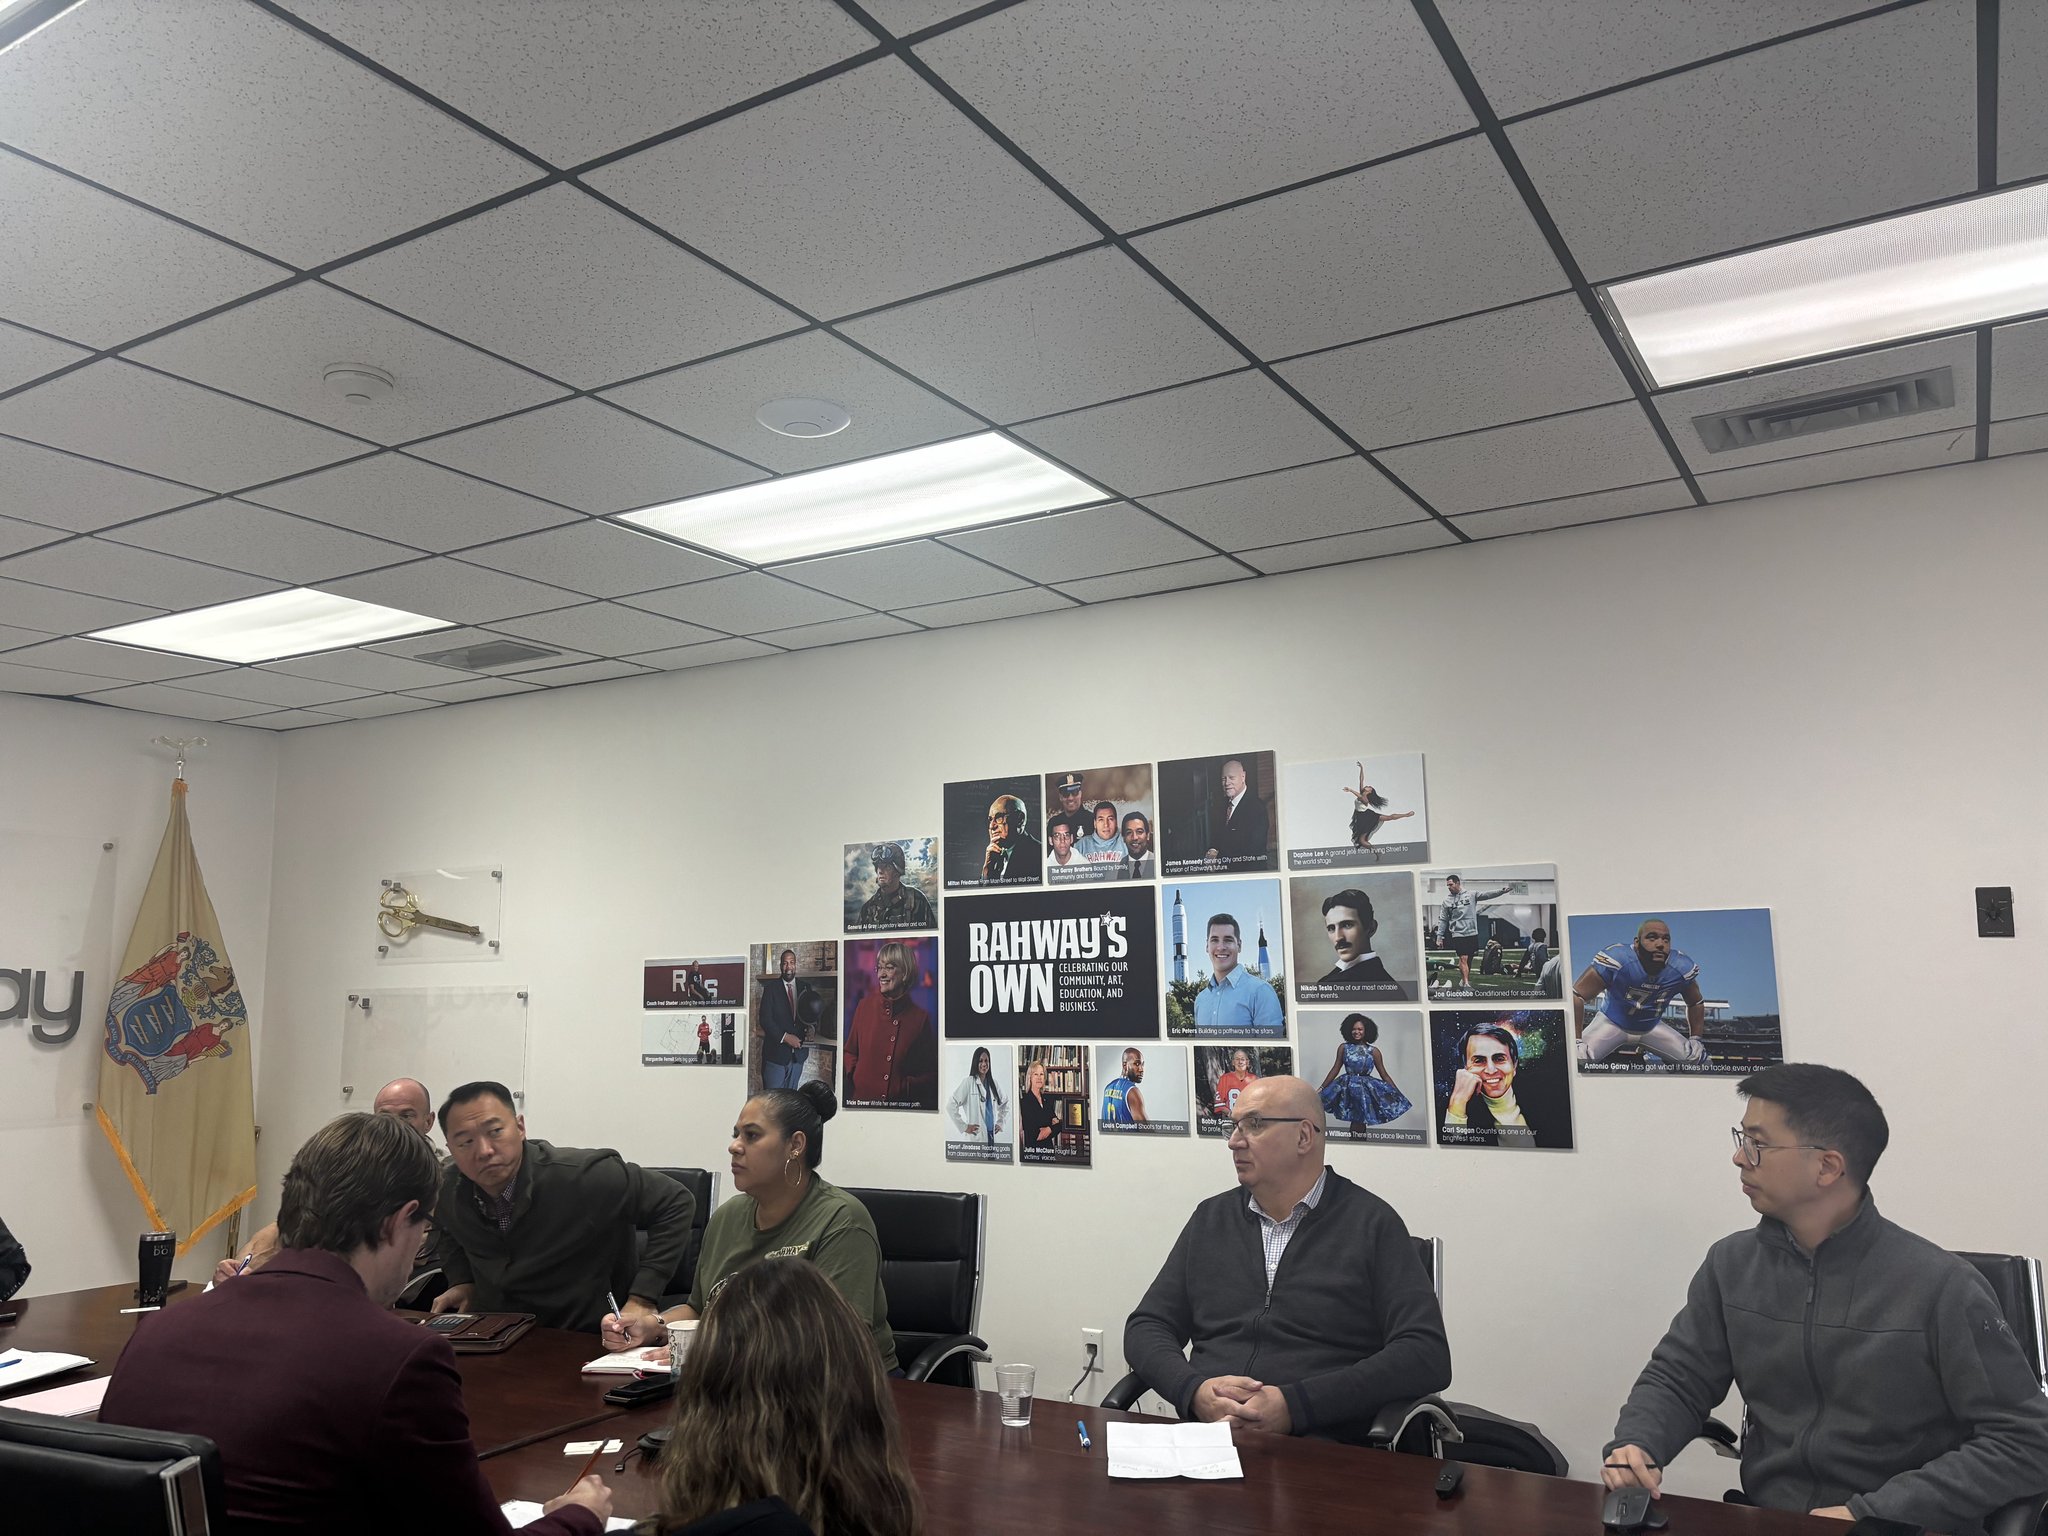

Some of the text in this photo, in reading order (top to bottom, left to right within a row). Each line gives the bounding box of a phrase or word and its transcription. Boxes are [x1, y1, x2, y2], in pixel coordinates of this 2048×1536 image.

[1330, 849, 1346, 858] grand
[1358, 847, 1370, 855] from
[1371, 846, 1385, 855] Irving
[1386, 845, 1402, 853] Street
[1402, 844, 1409, 852] to
[1165, 859, 1182, 867] James
[1182, 857, 1203, 866] Kennedy
[1203, 856, 1222, 866] Serving
[1222, 856, 1232, 864] City
[1256, 853, 1268, 861] with
[1060, 867, 1073, 875] Garay
[1108, 864, 1115, 872] by
[1189, 864, 1214, 874] Rahway's
[947, 879, 960, 887] Milton
[960, 878, 980, 886] Friedman
[878, 921, 897, 930] Legendary
[1058, 961, 1129, 974] CELEBRATING OUR
[672, 969, 719, 998] RS
[1059, 974, 1124, 987] COMMUNITY, ART,
[970, 962, 1054, 1014] OWN
[1300, 984, 1318, 992] Nikola
[1059, 987, 1123, 1000] EDUCATION, AND
[1059, 1001, 1099, 1013] BUSINESS.
[1198, 1027, 1218, 1035] Building
[1222, 1027, 1244, 1035] pathway
[1610, 1062, 1630, 1071] Garay
[1645, 1063, 1657, 1071] got
[1115, 1122, 1138, 1130] Campbell
[1201, 1117, 1217, 1126] Bobby
[1329, 1130, 1352, 1138] Williams
[1380, 1132, 1396, 1140] place
[1456, 1126, 1475, 1135] Sagan
[1475, 1127, 1498, 1135] Counts
[1519, 1128, 1527, 1136] of
[1442, 1134, 1487, 1143] brightest stars.
